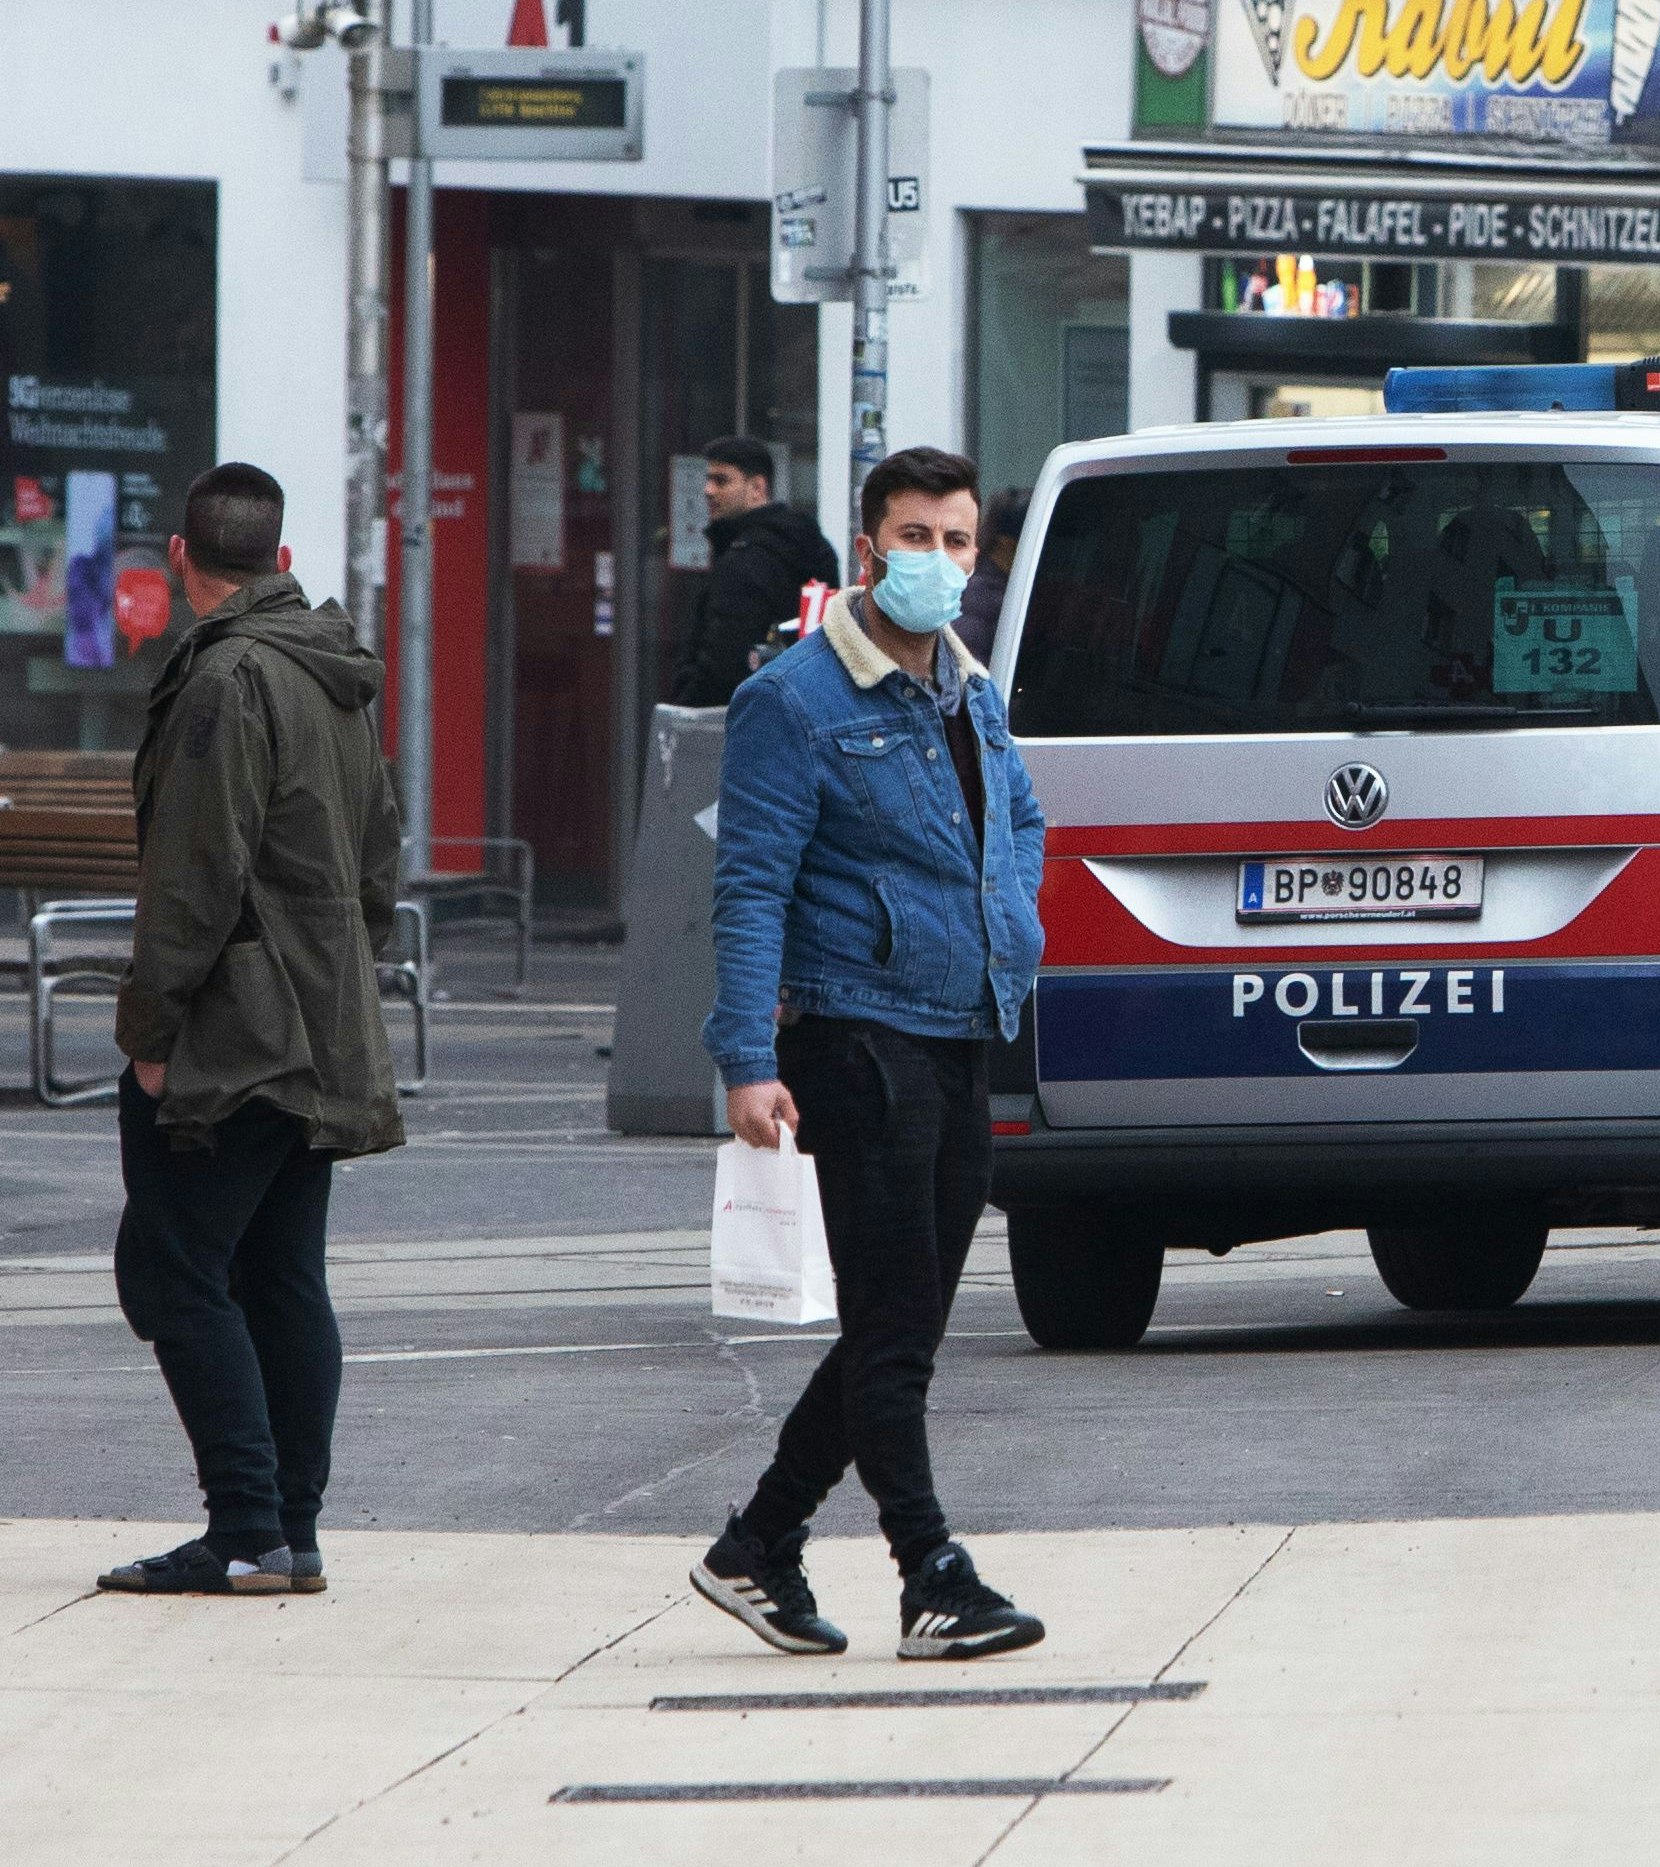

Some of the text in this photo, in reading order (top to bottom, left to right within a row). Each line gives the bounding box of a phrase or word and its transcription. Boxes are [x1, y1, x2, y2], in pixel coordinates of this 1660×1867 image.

[1121, 194, 1205, 238] KEBAP
[1227, 196, 1298, 241] PIZZA
[1316, 199, 1427, 246] FALAFEL
[1448, 203, 1507, 248] PIDE
[1543, 618, 1582, 643] U
[1521, 646, 1602, 676] 132
[1248, 864, 1462, 903] A BP 90848
[1232, 970, 1505, 1018] POLIZEI
